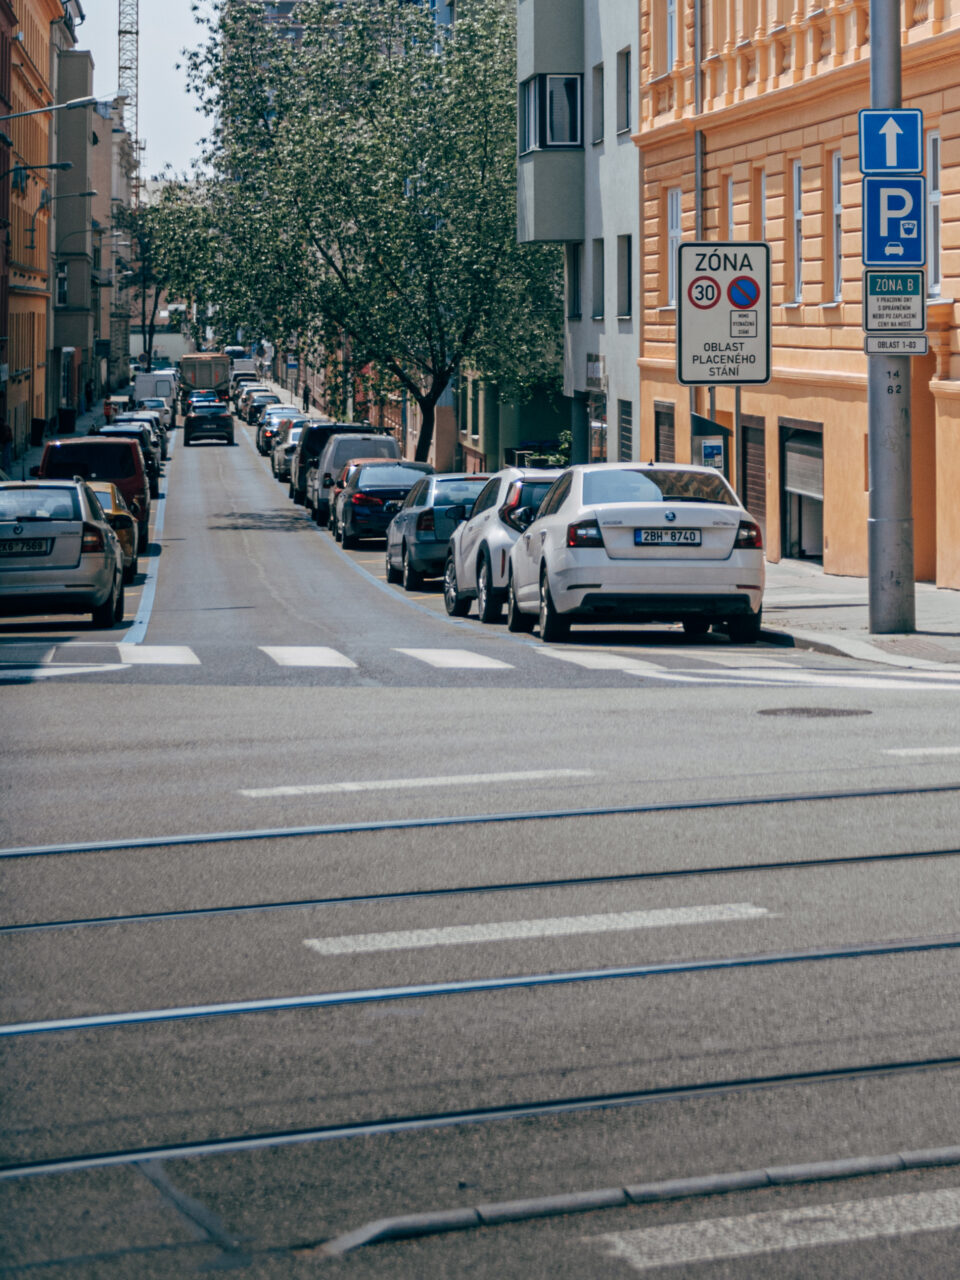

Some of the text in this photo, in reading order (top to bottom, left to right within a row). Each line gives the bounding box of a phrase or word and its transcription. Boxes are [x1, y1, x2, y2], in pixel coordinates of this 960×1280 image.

[880, 187, 914, 237] P
[695, 248, 753, 272] ZÓNA
[875, 276, 914, 292] ZÓNA B
[694, 284, 715, 301] 30
[703, 342, 745, 353] OBLAST
[877, 341, 900, 349] OBLAST
[692, 351, 756, 365] PLACENÉHO
[708, 364, 740, 377] STÁNÍ
[886, 370, 900, 379] 14
[887, 384, 902, 394] 62
[643, 531, 696, 542] 2BH 8740
